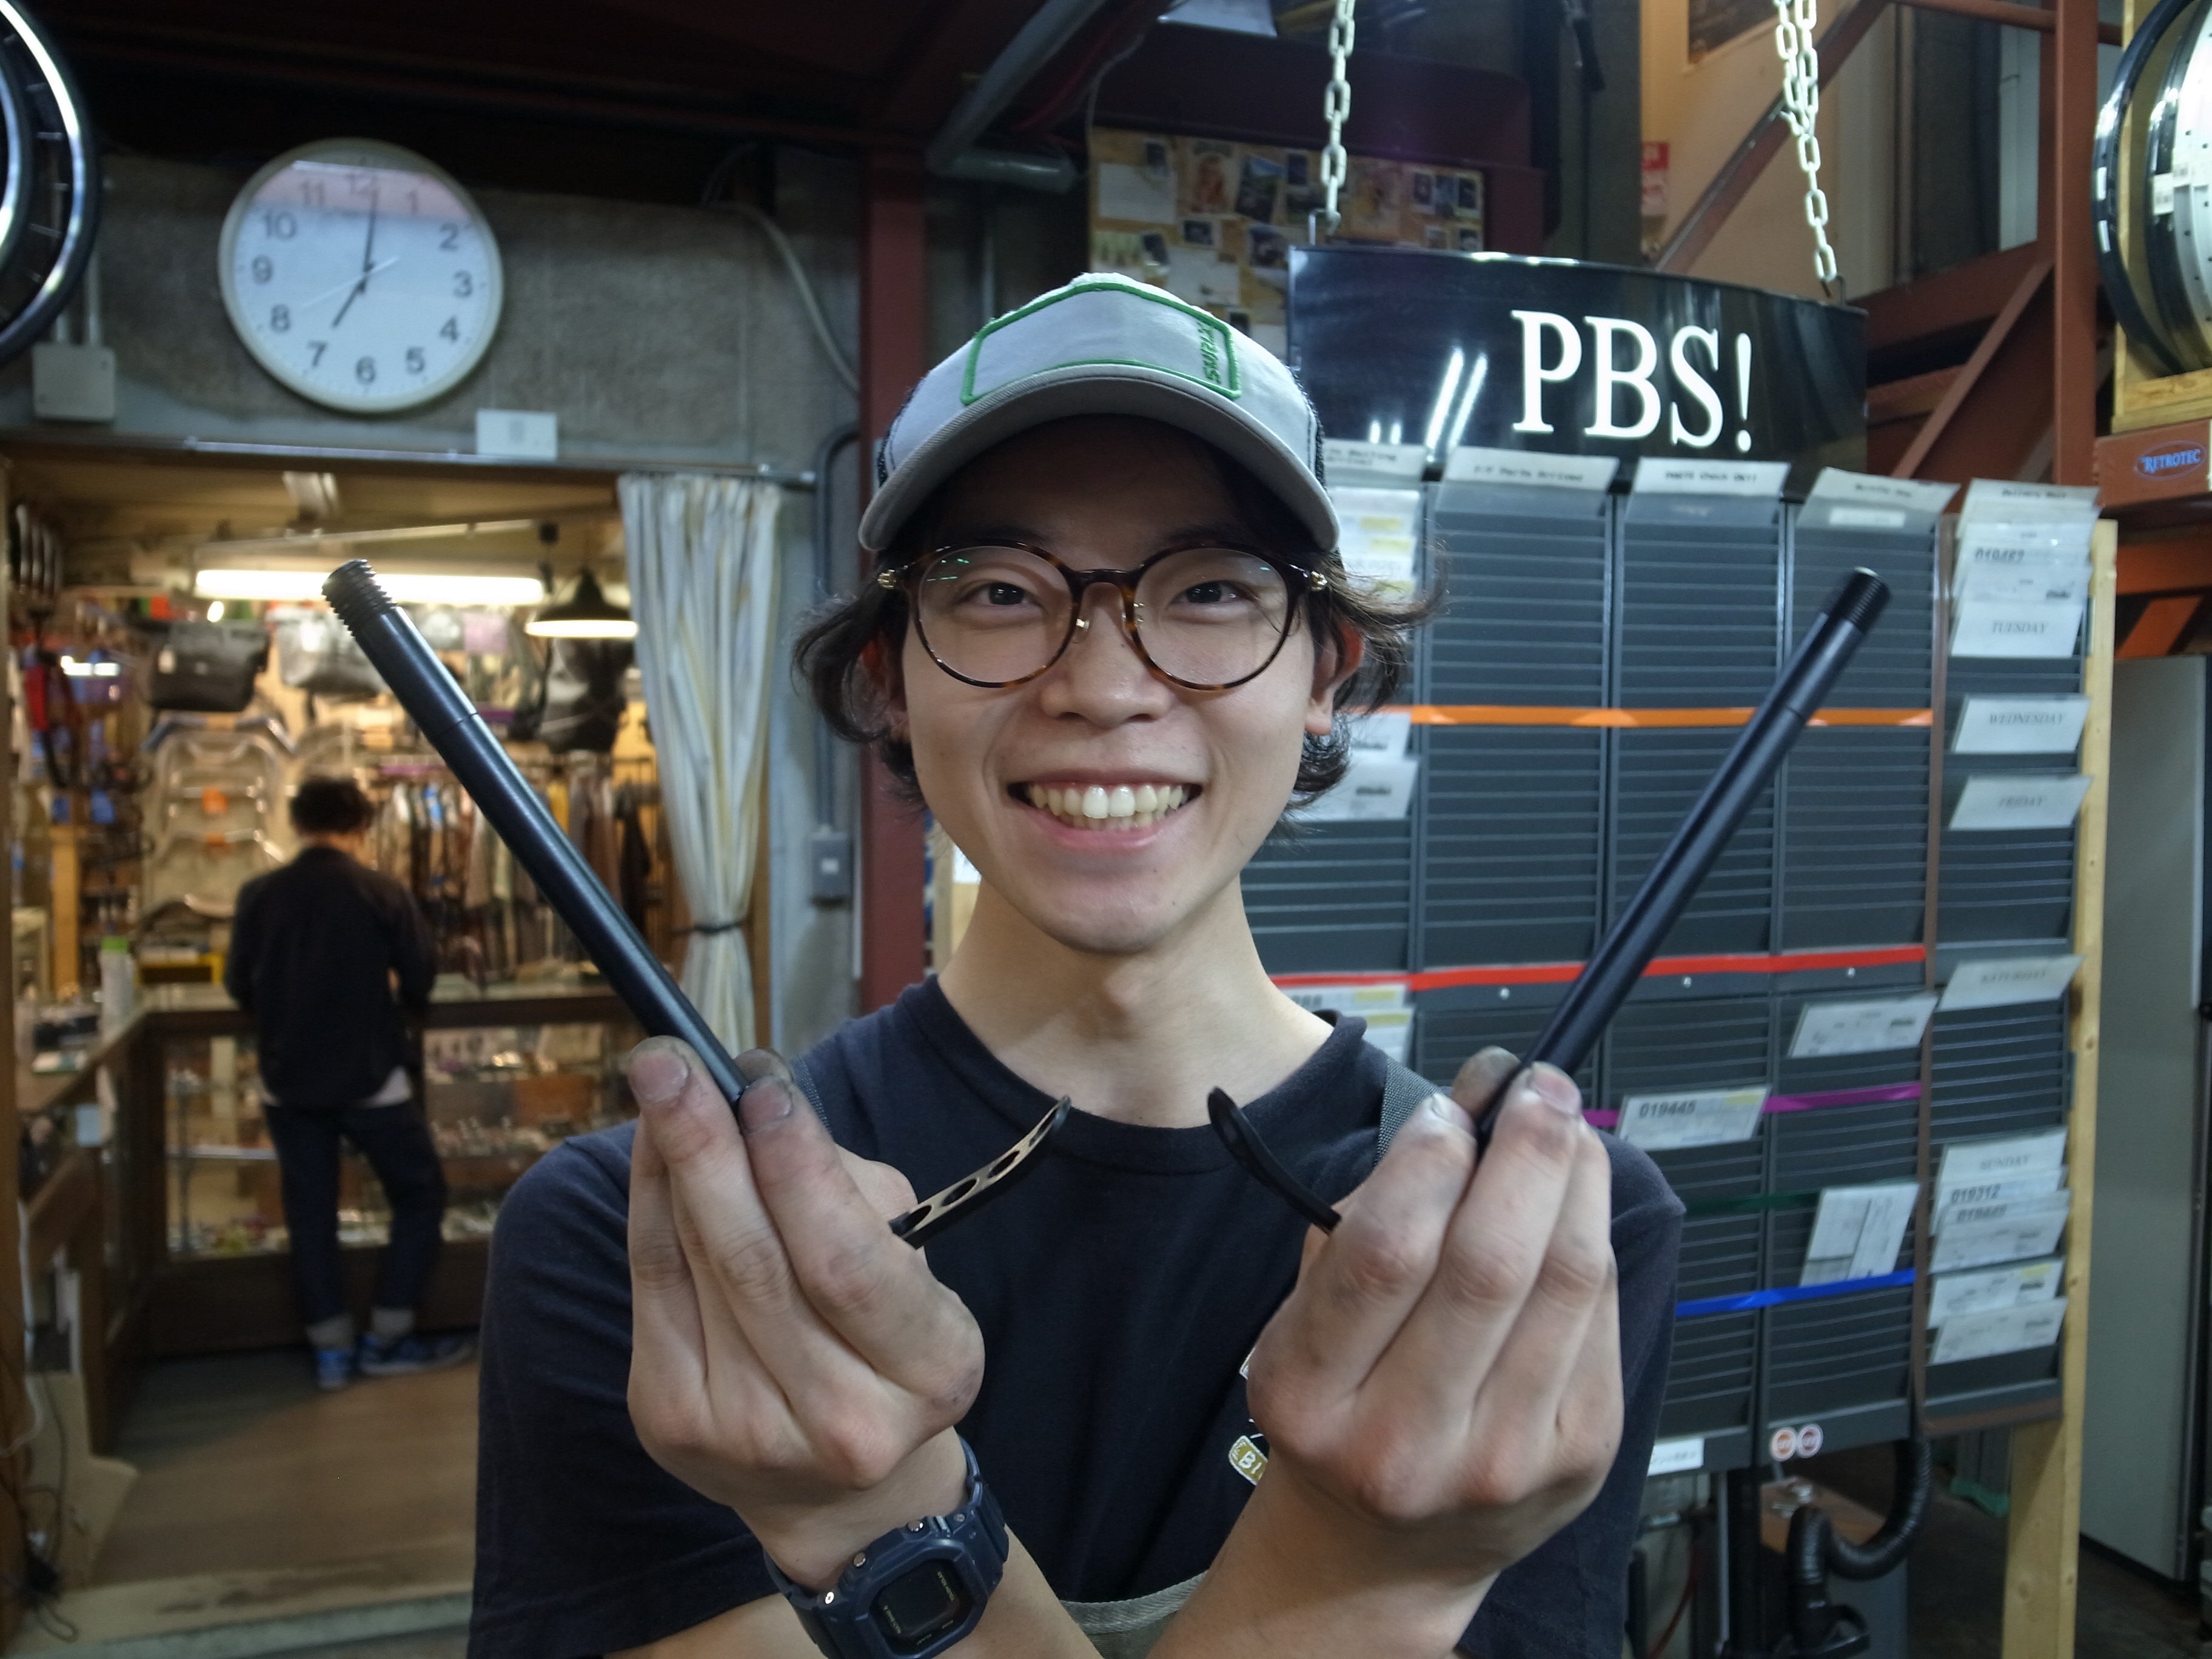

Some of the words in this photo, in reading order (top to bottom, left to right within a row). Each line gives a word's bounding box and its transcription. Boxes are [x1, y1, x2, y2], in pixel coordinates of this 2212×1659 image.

[263, 210, 297, 241] 10
[439, 222, 460, 251] 2
[252, 255, 273, 284] 9
[453, 270, 473, 298] 3
[270, 304, 291, 333] 8
[439, 316, 460, 343] 4
[307, 340, 328, 367] 7
[405, 346, 425, 374] 5
[355, 356, 377, 384] 6
[1511, 309, 1752, 452] PBS!
